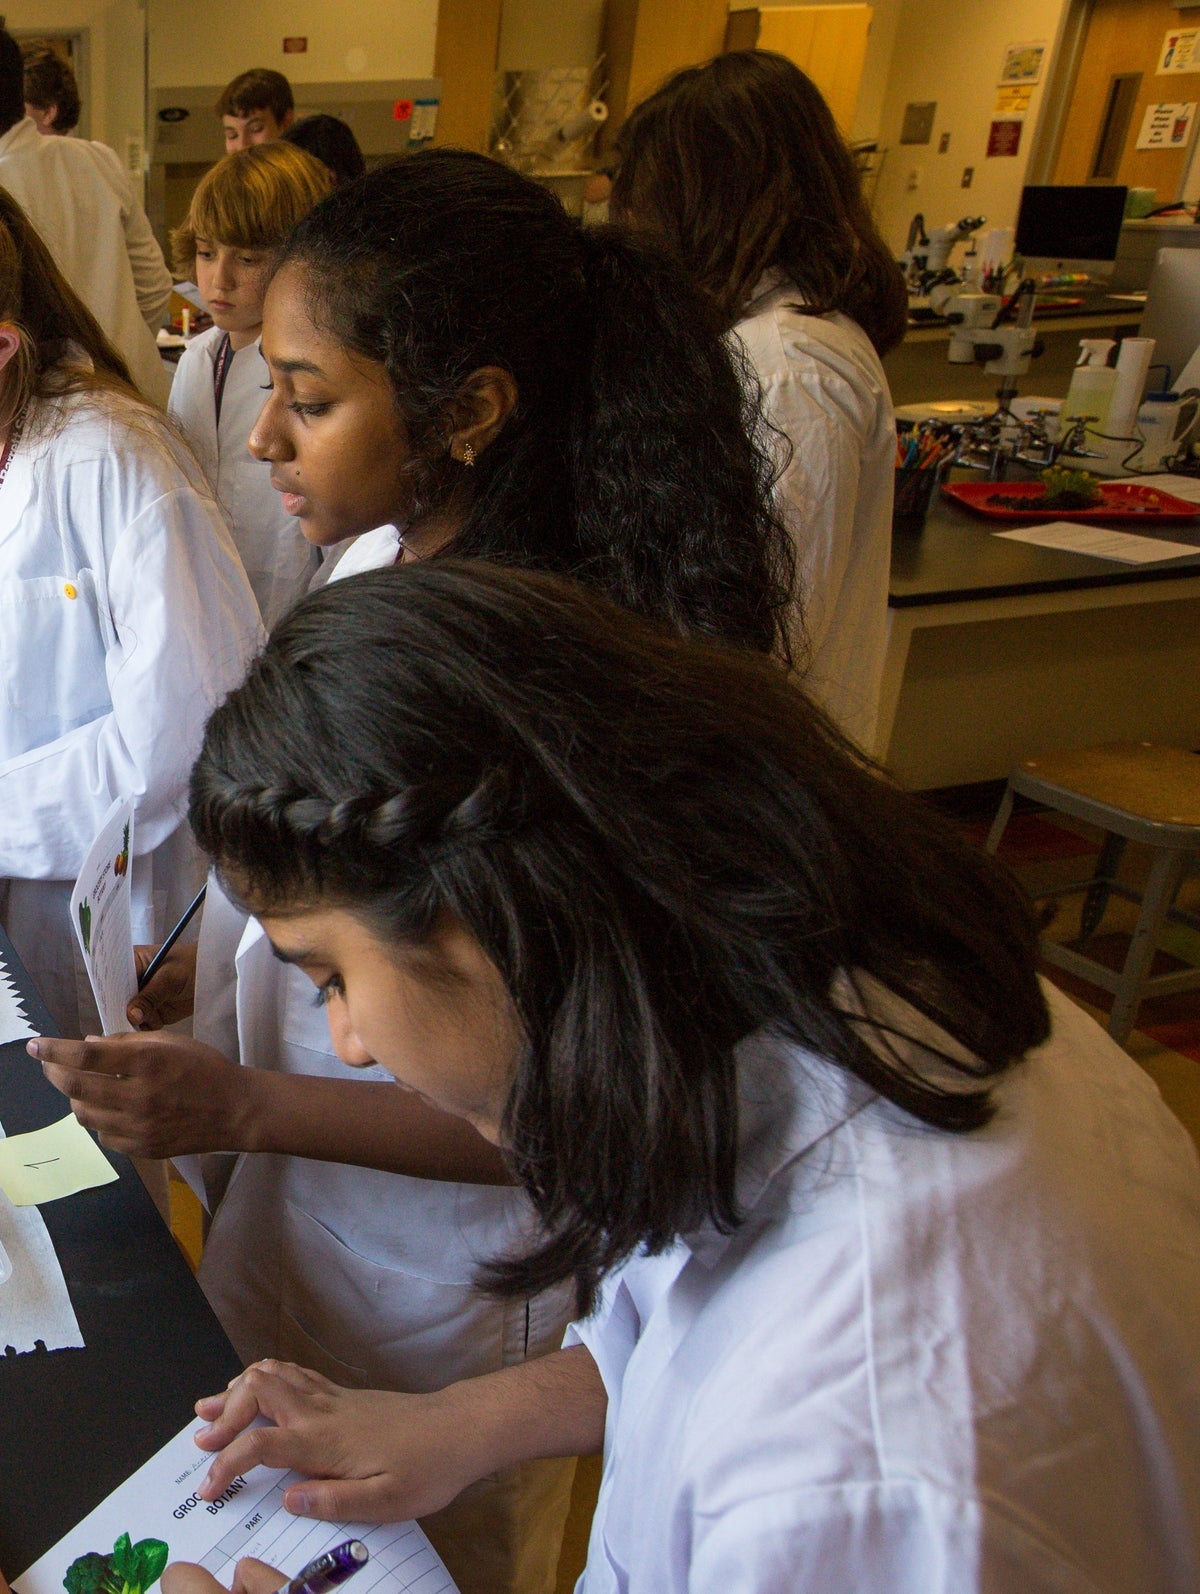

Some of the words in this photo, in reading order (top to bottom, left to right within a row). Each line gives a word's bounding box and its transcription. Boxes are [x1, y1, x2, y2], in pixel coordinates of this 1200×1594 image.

[23, 1157, 60, 1170] 1
[172, 1492, 203, 1520] GROC
[206, 1475, 248, 1515] BOTANY
[245, 1512, 263, 1531] PART
